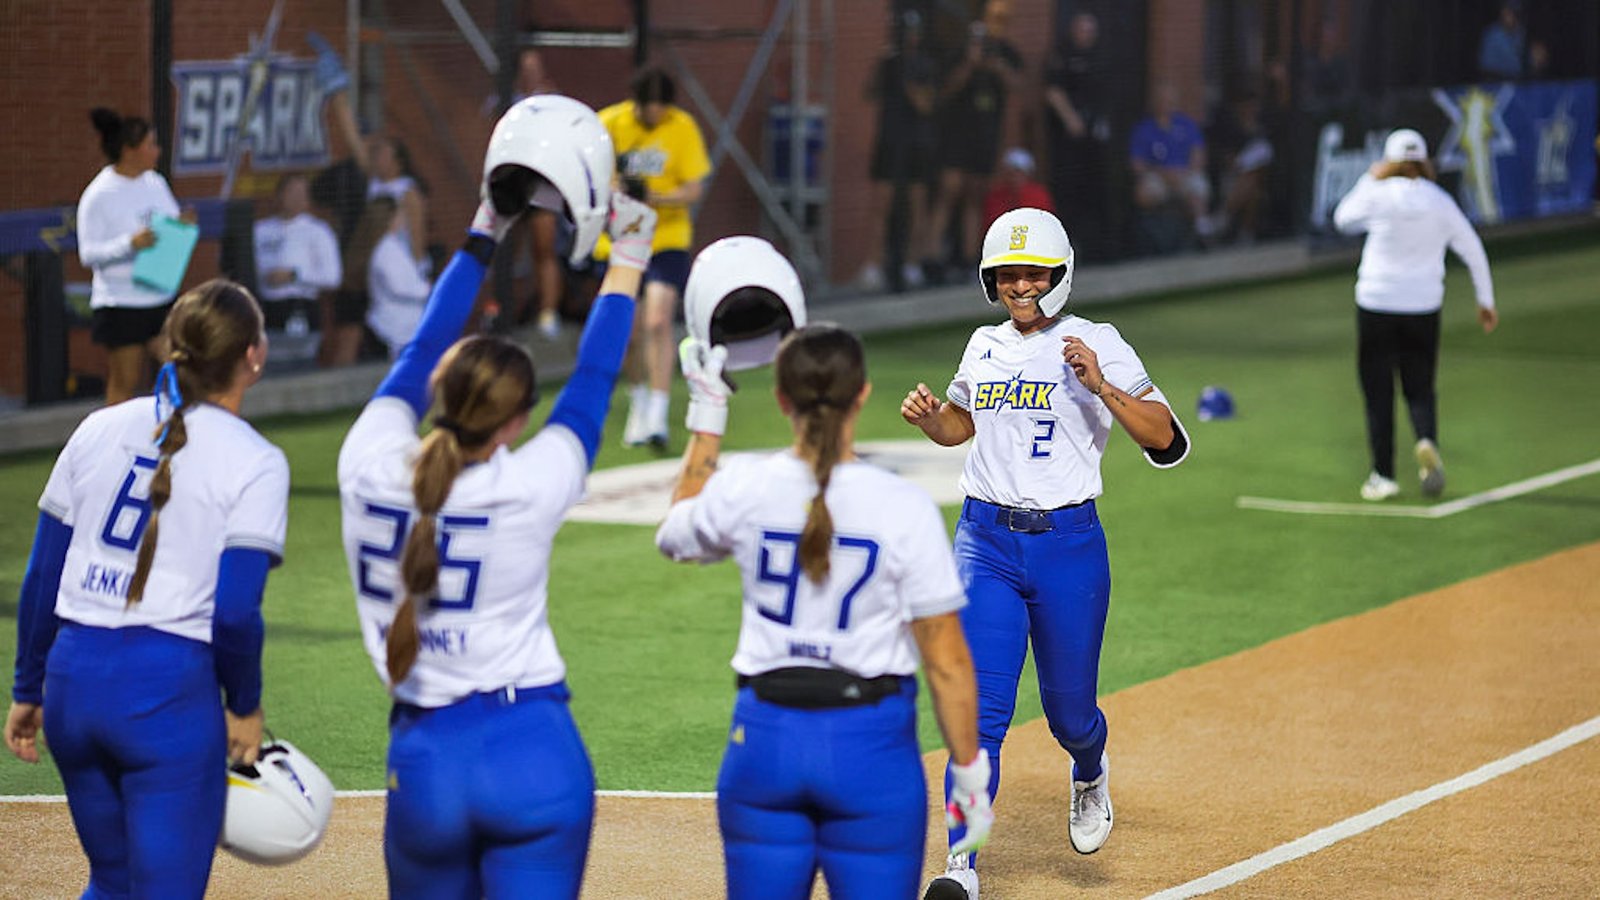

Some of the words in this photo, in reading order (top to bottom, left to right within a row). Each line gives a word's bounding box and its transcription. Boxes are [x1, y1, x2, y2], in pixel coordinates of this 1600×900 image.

[183, 74, 328, 160] SPARK
[975, 379, 1058, 411] SPARK
[1030, 419, 1056, 458] 2
[101, 455, 159, 551] 6
[358, 502, 489, 610] 25
[757, 531, 879, 630] 97
